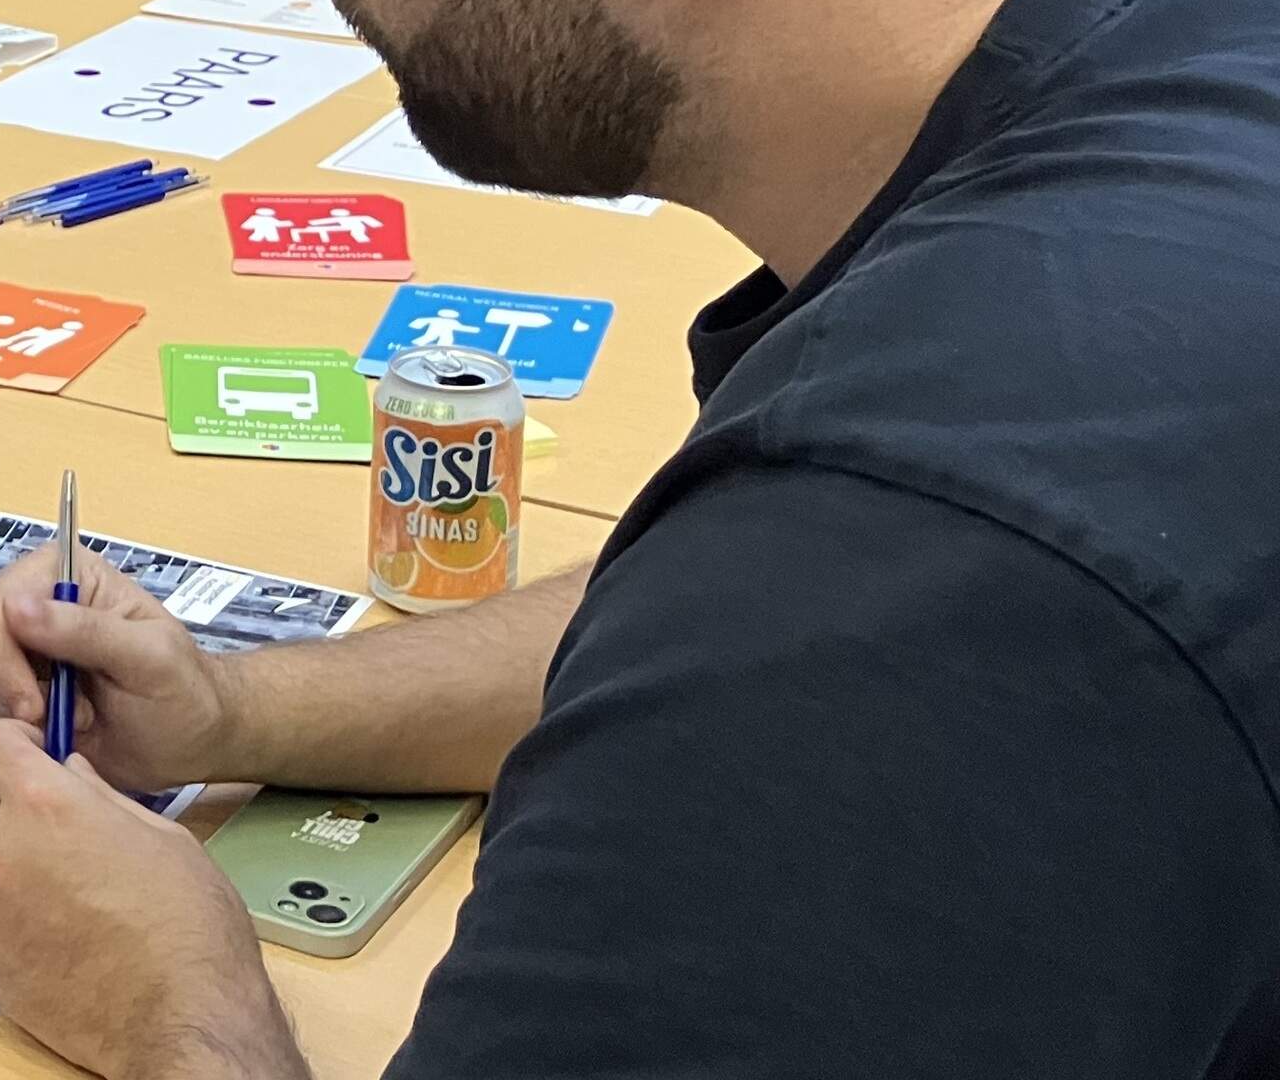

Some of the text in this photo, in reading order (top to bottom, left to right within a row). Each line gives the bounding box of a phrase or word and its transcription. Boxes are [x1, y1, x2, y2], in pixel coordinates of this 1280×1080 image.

[101, 47, 279, 122] PAARS
[384, 395, 413, 415] ZERO
[405, 511, 480, 543] SINAS
